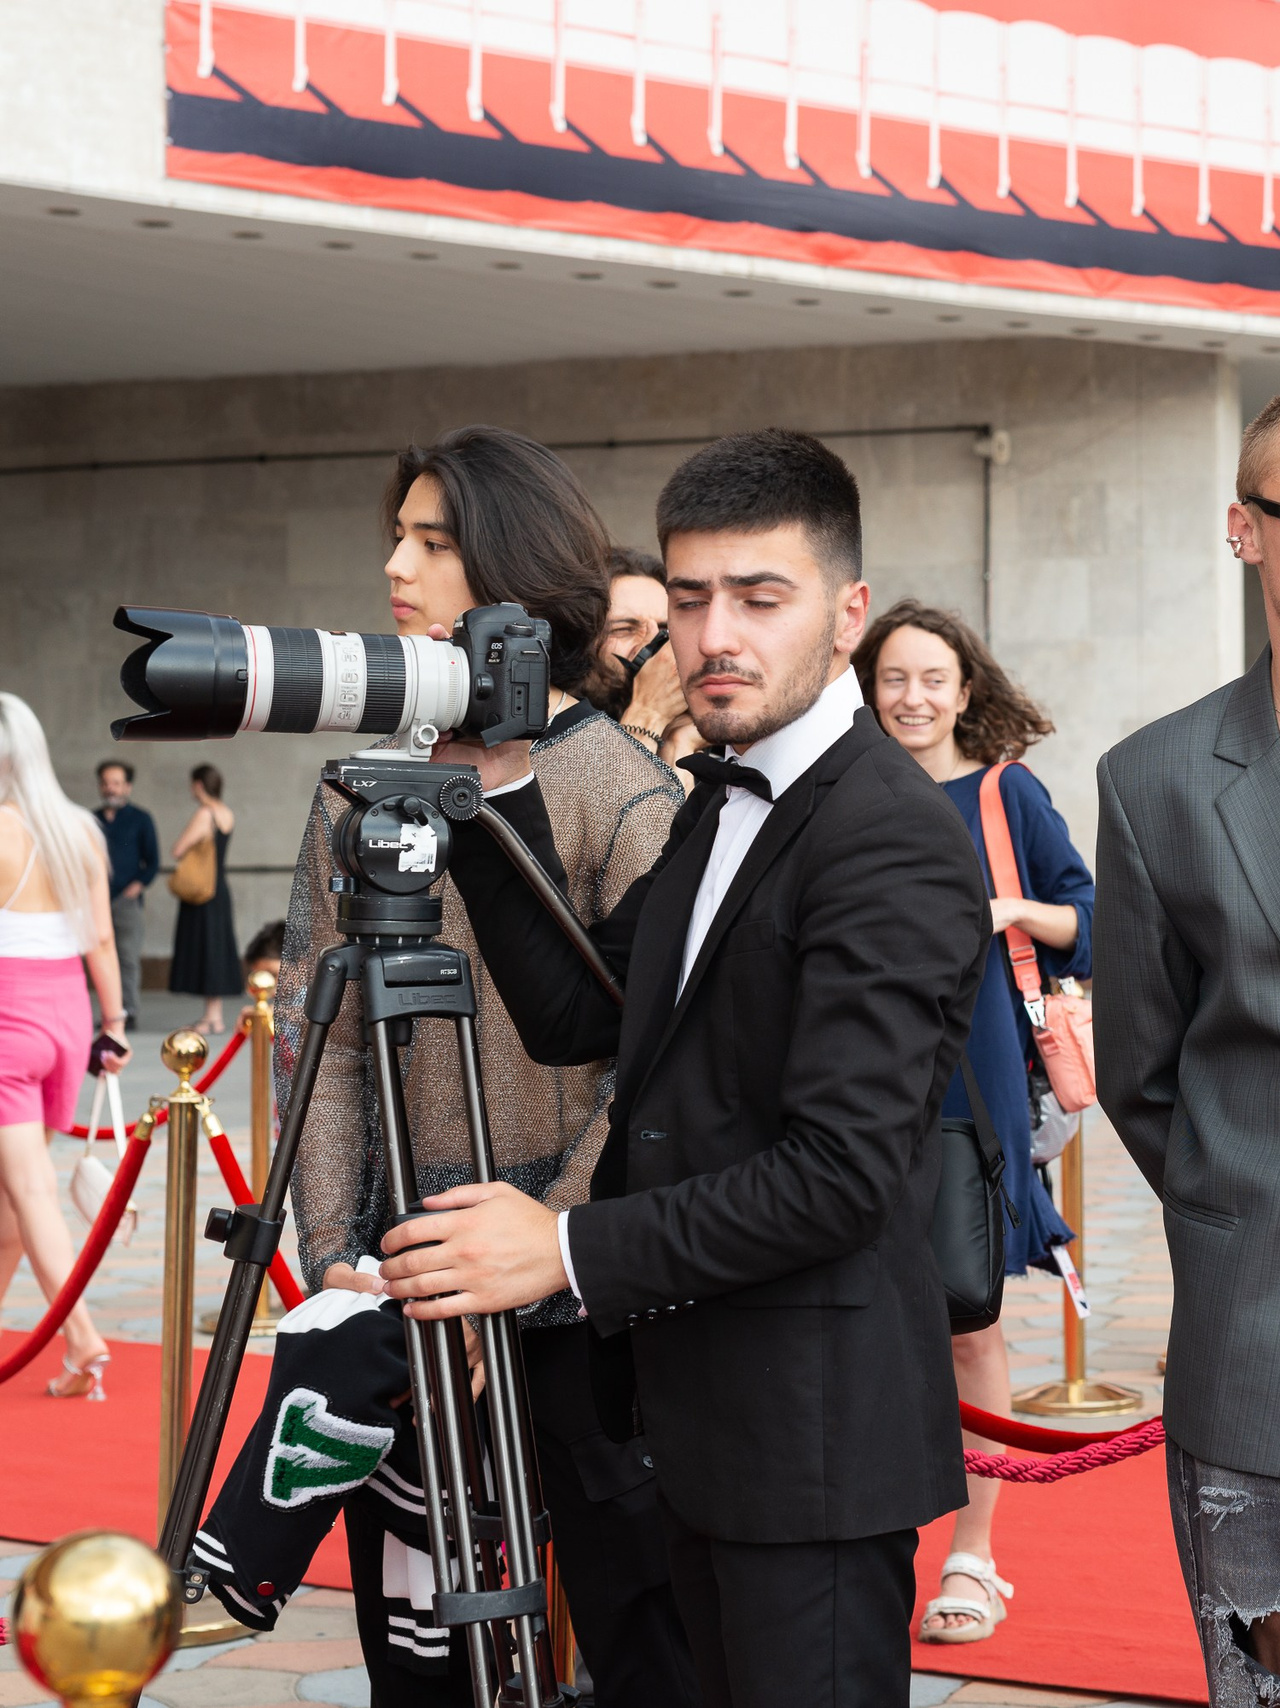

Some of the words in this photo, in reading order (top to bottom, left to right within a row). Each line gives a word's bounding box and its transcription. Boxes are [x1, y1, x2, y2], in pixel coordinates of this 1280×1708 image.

[491, 642, 503, 650] EOS
[352, 780, 377, 788] LX7
[398, 992, 457, 1007] Libec
